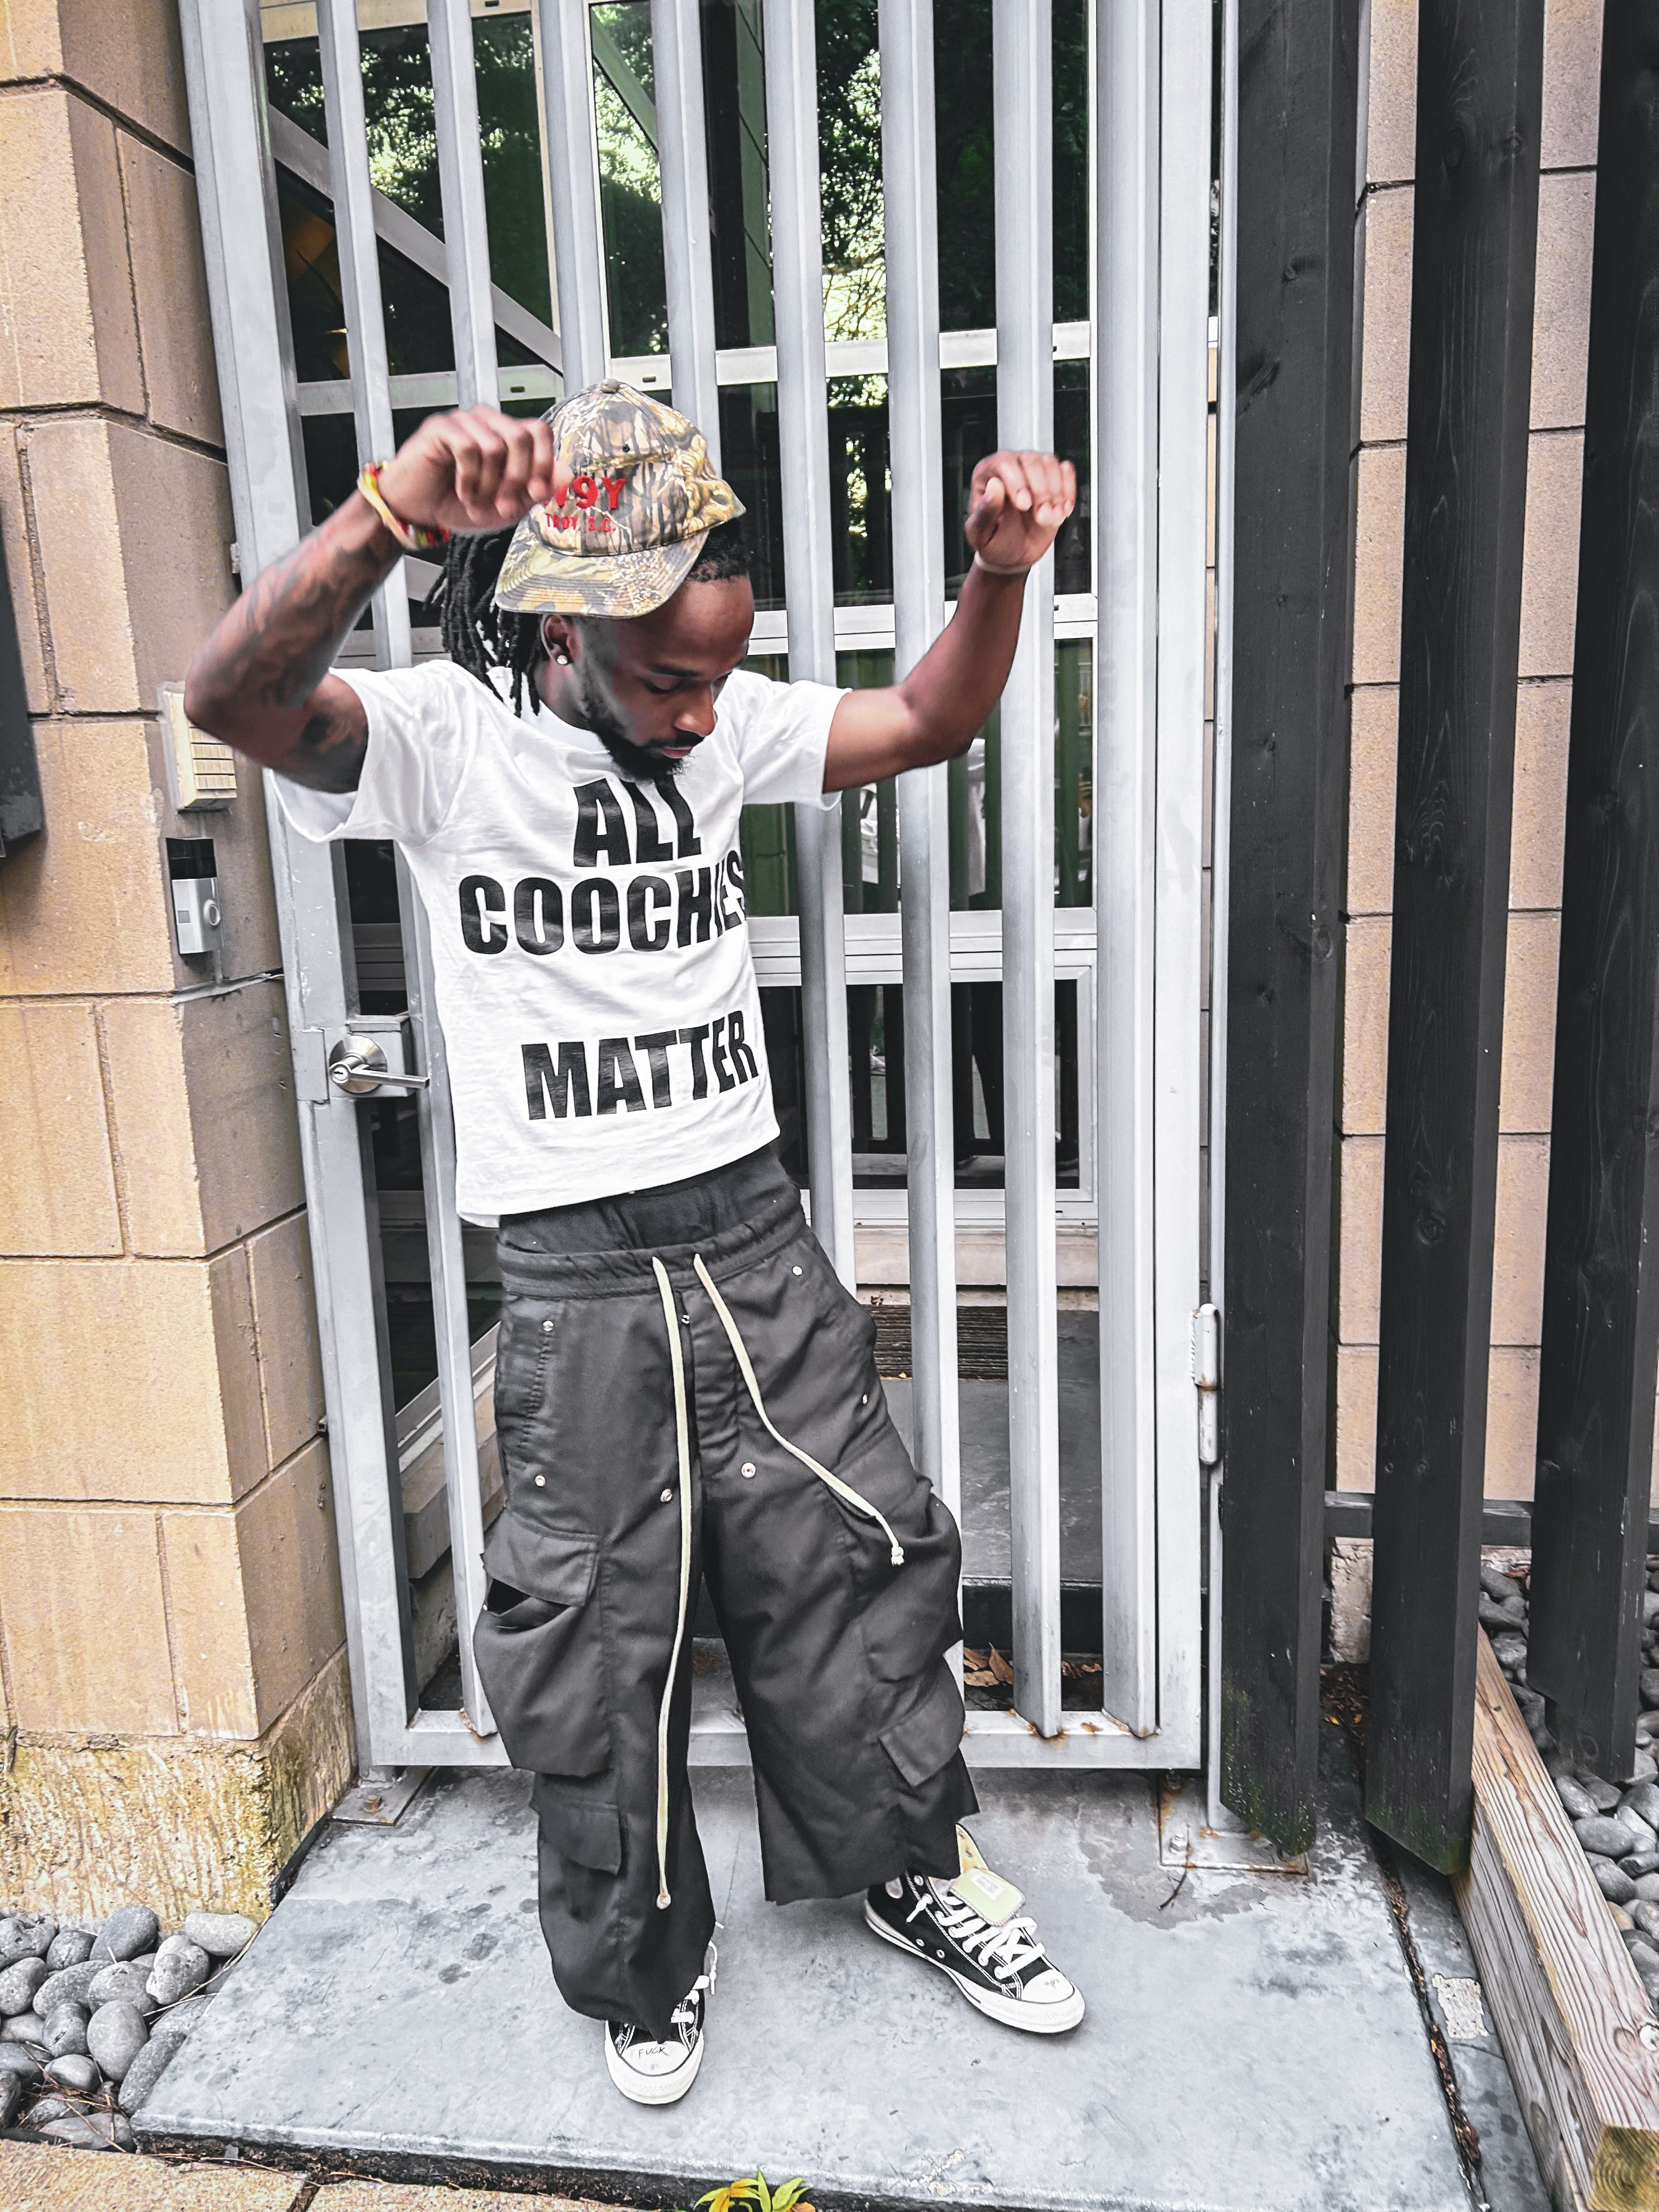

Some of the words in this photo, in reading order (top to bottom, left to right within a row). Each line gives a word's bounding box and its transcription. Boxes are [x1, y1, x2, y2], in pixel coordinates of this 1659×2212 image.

[588, 516, 616, 532] S.C.
[573, 775, 701, 867] ALL
[459, 850, 746, 955] COOCHIES
[521, 1011, 759, 1120] MATTER
